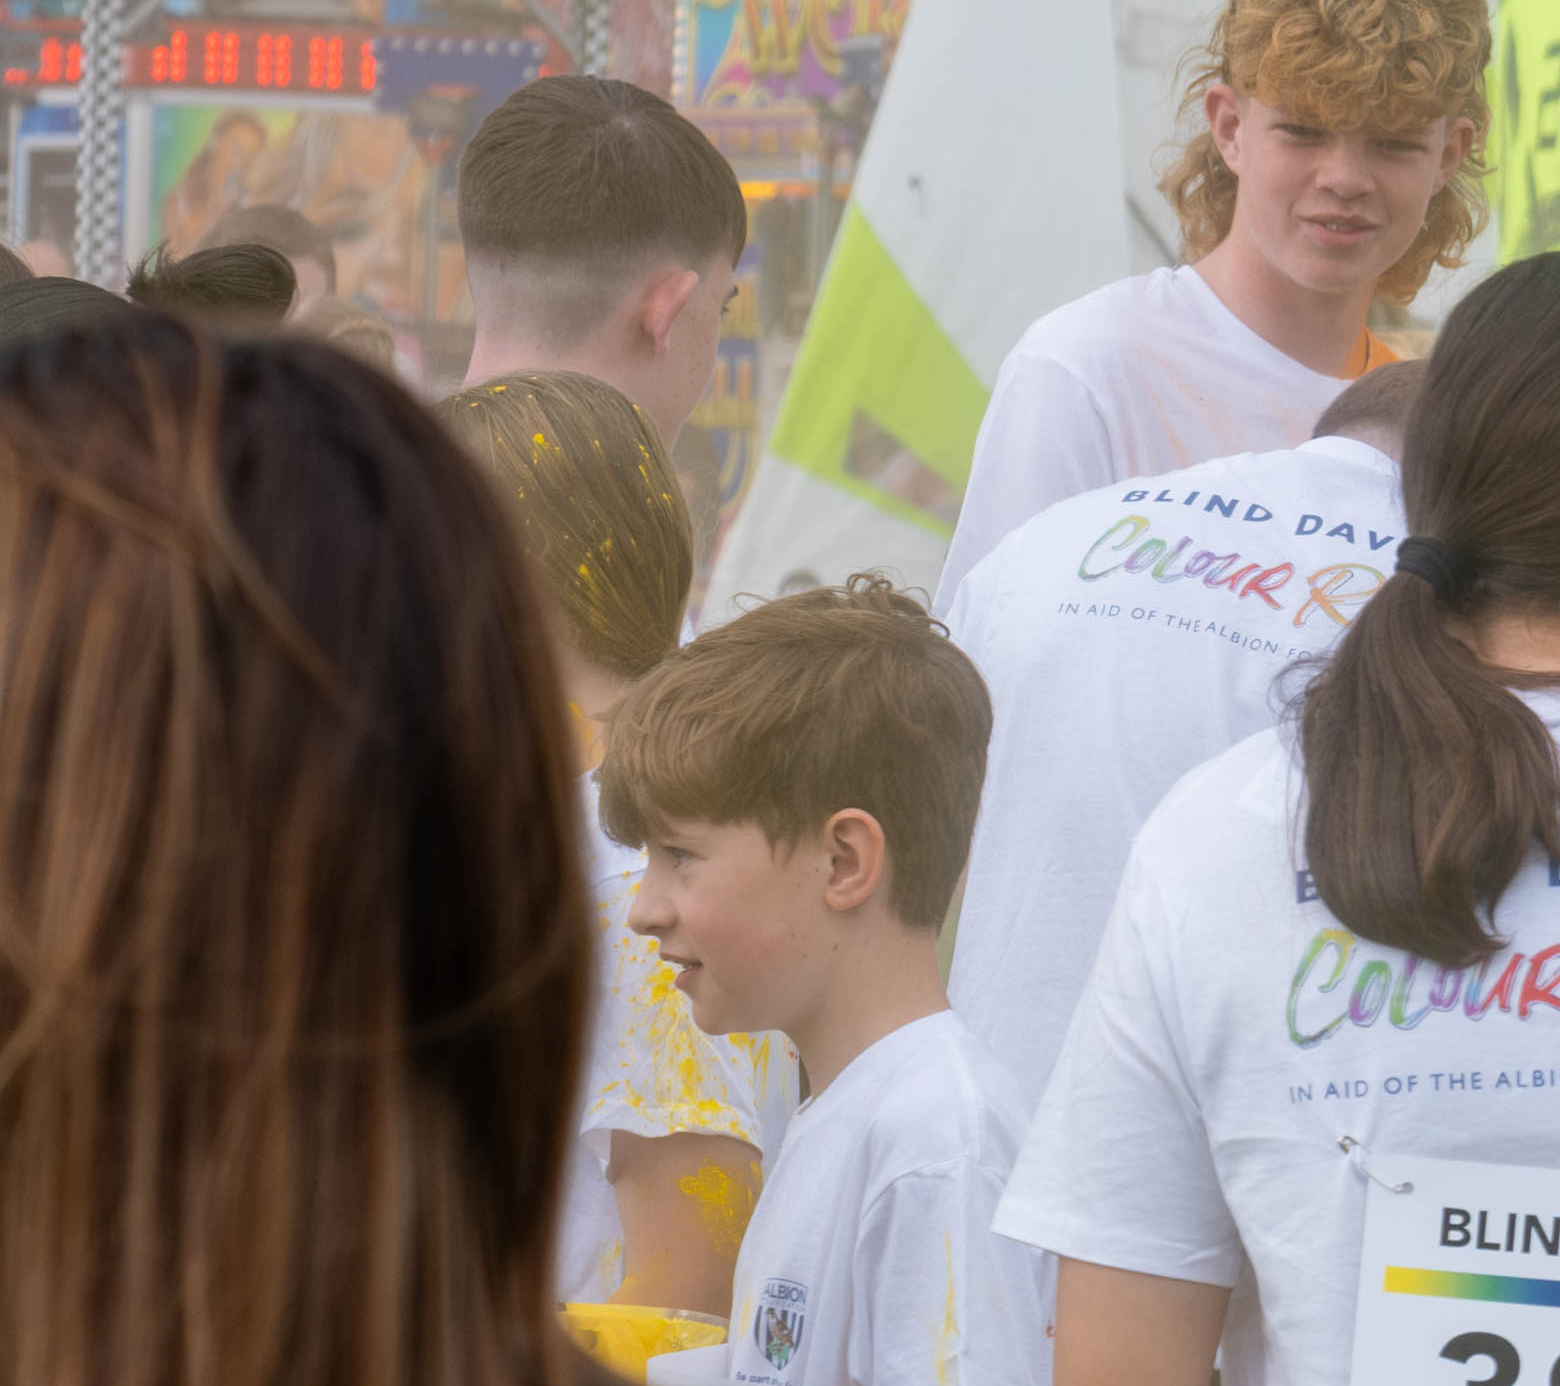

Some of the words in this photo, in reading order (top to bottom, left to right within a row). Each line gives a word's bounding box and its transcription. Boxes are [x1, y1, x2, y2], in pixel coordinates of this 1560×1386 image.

[1120, 489, 1273, 523] BLIND
[1296, 514, 1399, 551] DAV
[1059, 602, 1079, 616] IN
[1087, 604, 1120, 619] AID
[1133, 607, 1159, 623] OF
[1167, 614, 1201, 633] THE
[1206, 620, 1279, 655] ALBION
[1289, 1083, 1313, 1105] IN
[1324, 1077, 1370, 1100] AID
[1384, 1074, 1420, 1095] OF
[1430, 1070, 1483, 1091] THE
[763, 1283, 807, 1305] ALBION
